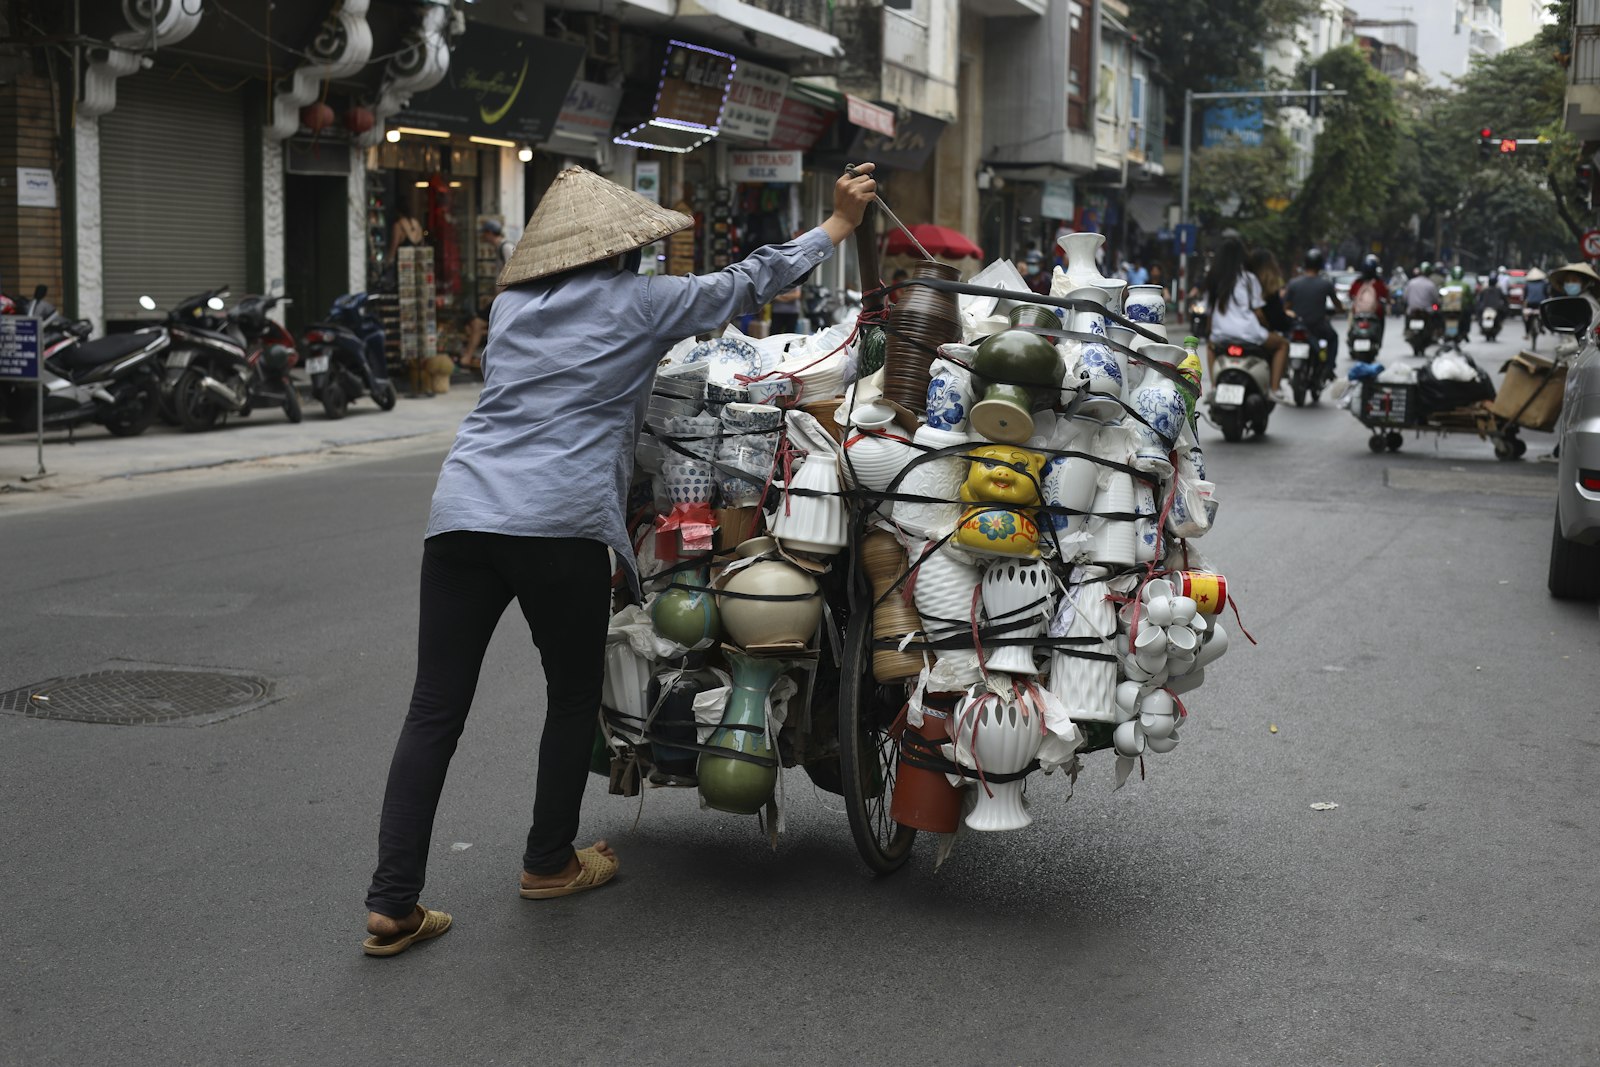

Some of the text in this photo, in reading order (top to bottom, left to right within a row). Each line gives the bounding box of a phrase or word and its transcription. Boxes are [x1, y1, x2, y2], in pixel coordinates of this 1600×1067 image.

[733, 153, 793, 166] MAI TRANG
[748, 167, 777, 178] SILK
